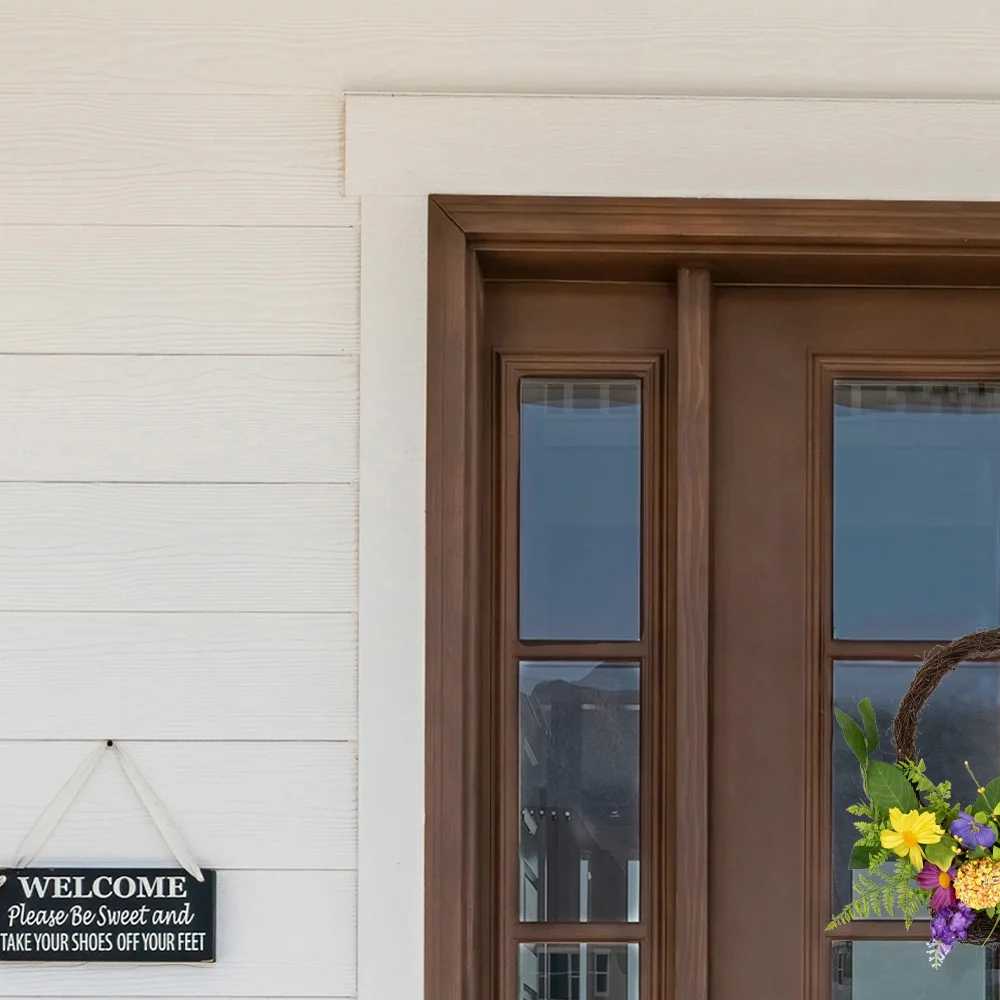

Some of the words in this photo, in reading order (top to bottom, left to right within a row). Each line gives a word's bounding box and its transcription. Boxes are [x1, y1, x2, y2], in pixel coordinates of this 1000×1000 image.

[17, 876, 187, 899] WELCOME
[8, 902, 69, 927] Please
[70, 904, 96, 926] Be
[97, 904, 150, 927] Sweet
[152, 902, 195, 925] and
[0, 932, 32, 951] TAKE
[33, 932, 69, 951] YOUR
[71, 932, 113, 951] SHOES
[116, 932, 140, 951] OFF
[141, 932, 175, 951] YOUR
[178, 932, 206, 951] FEET
